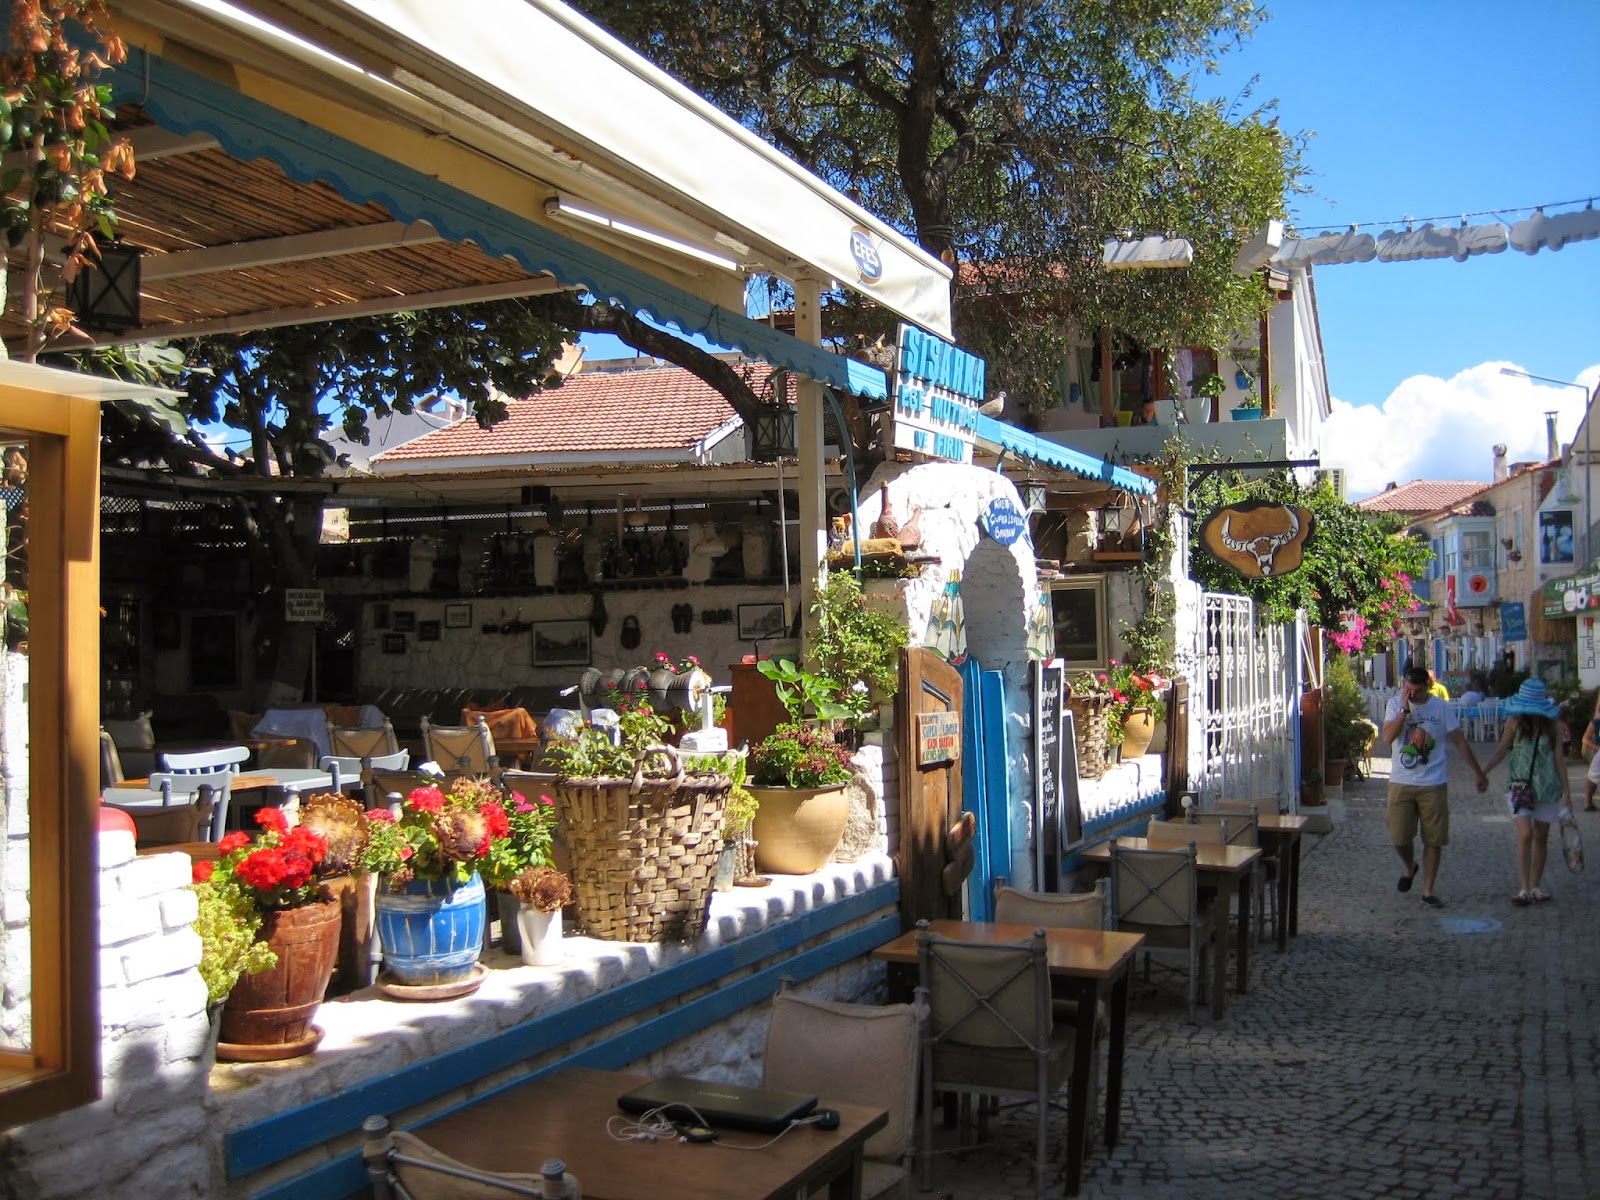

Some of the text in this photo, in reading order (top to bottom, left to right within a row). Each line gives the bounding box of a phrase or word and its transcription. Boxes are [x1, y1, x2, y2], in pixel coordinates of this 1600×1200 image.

[853, 235, 879, 268] EFES
[899, 384, 926, 412] EGE
[914, 431, 964, 461] VE FIRIN
[1555, 581, 1566, 592] Lig
